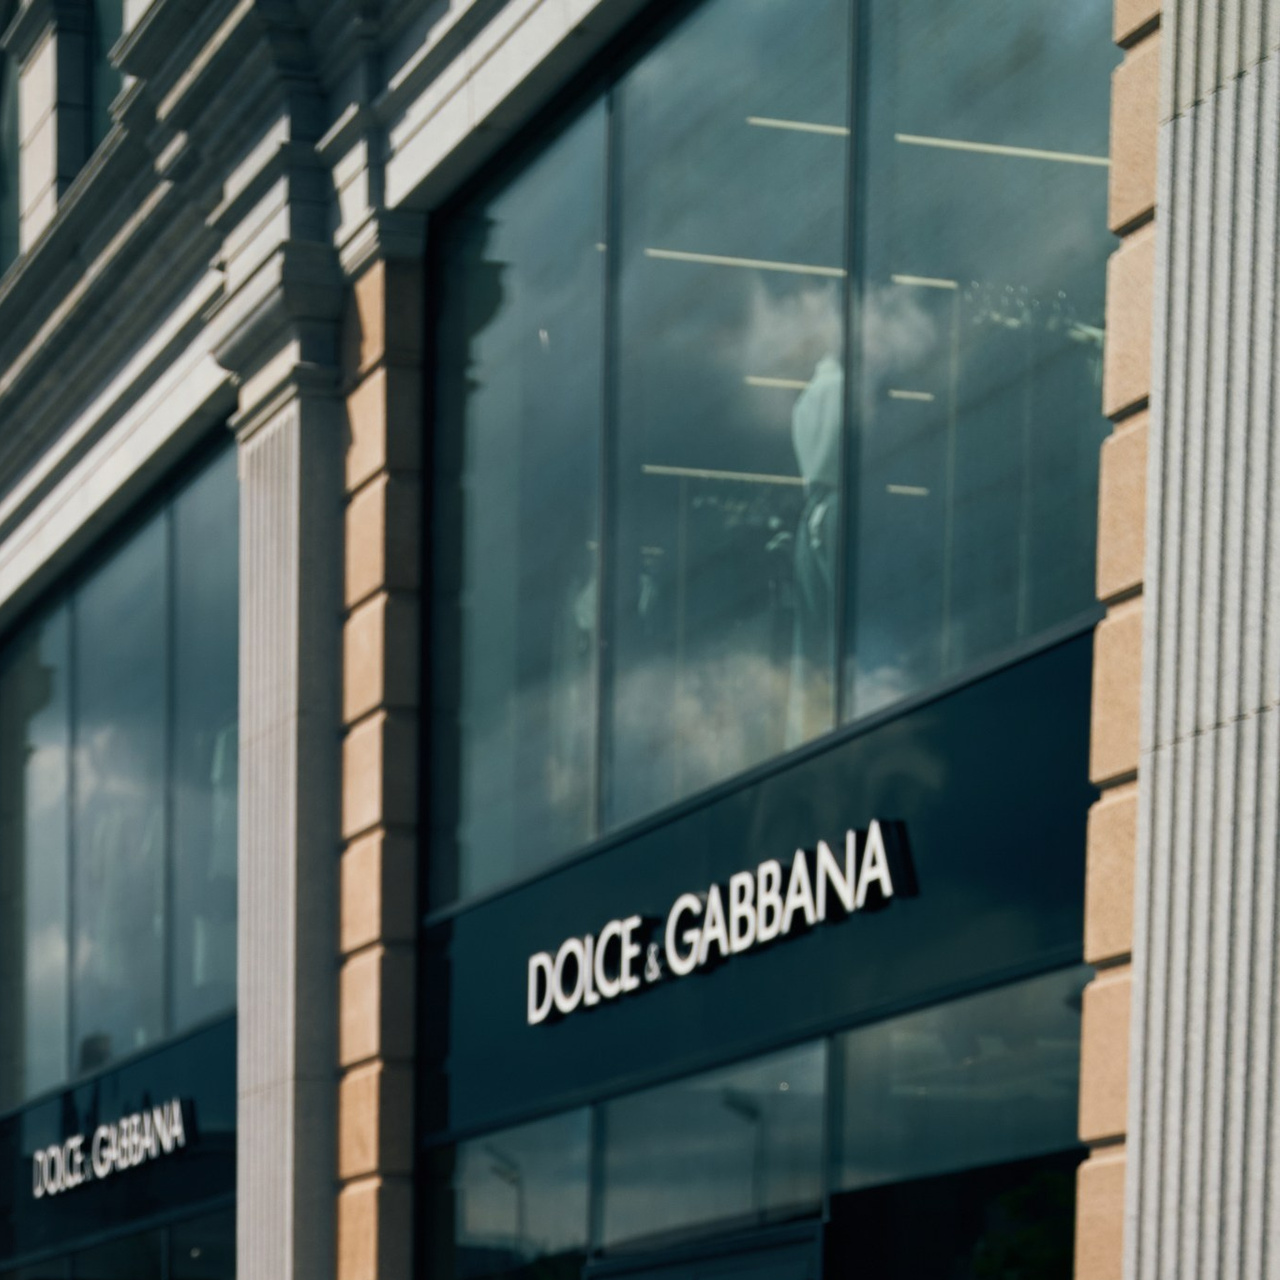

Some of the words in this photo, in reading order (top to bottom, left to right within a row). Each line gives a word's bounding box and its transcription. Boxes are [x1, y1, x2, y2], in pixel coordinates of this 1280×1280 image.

[527, 915, 642, 1026] DOLCE
[644, 942, 663, 983] &
[665, 818, 894, 977] GABBANA
[92, 1097, 186, 1180] GABBANA
